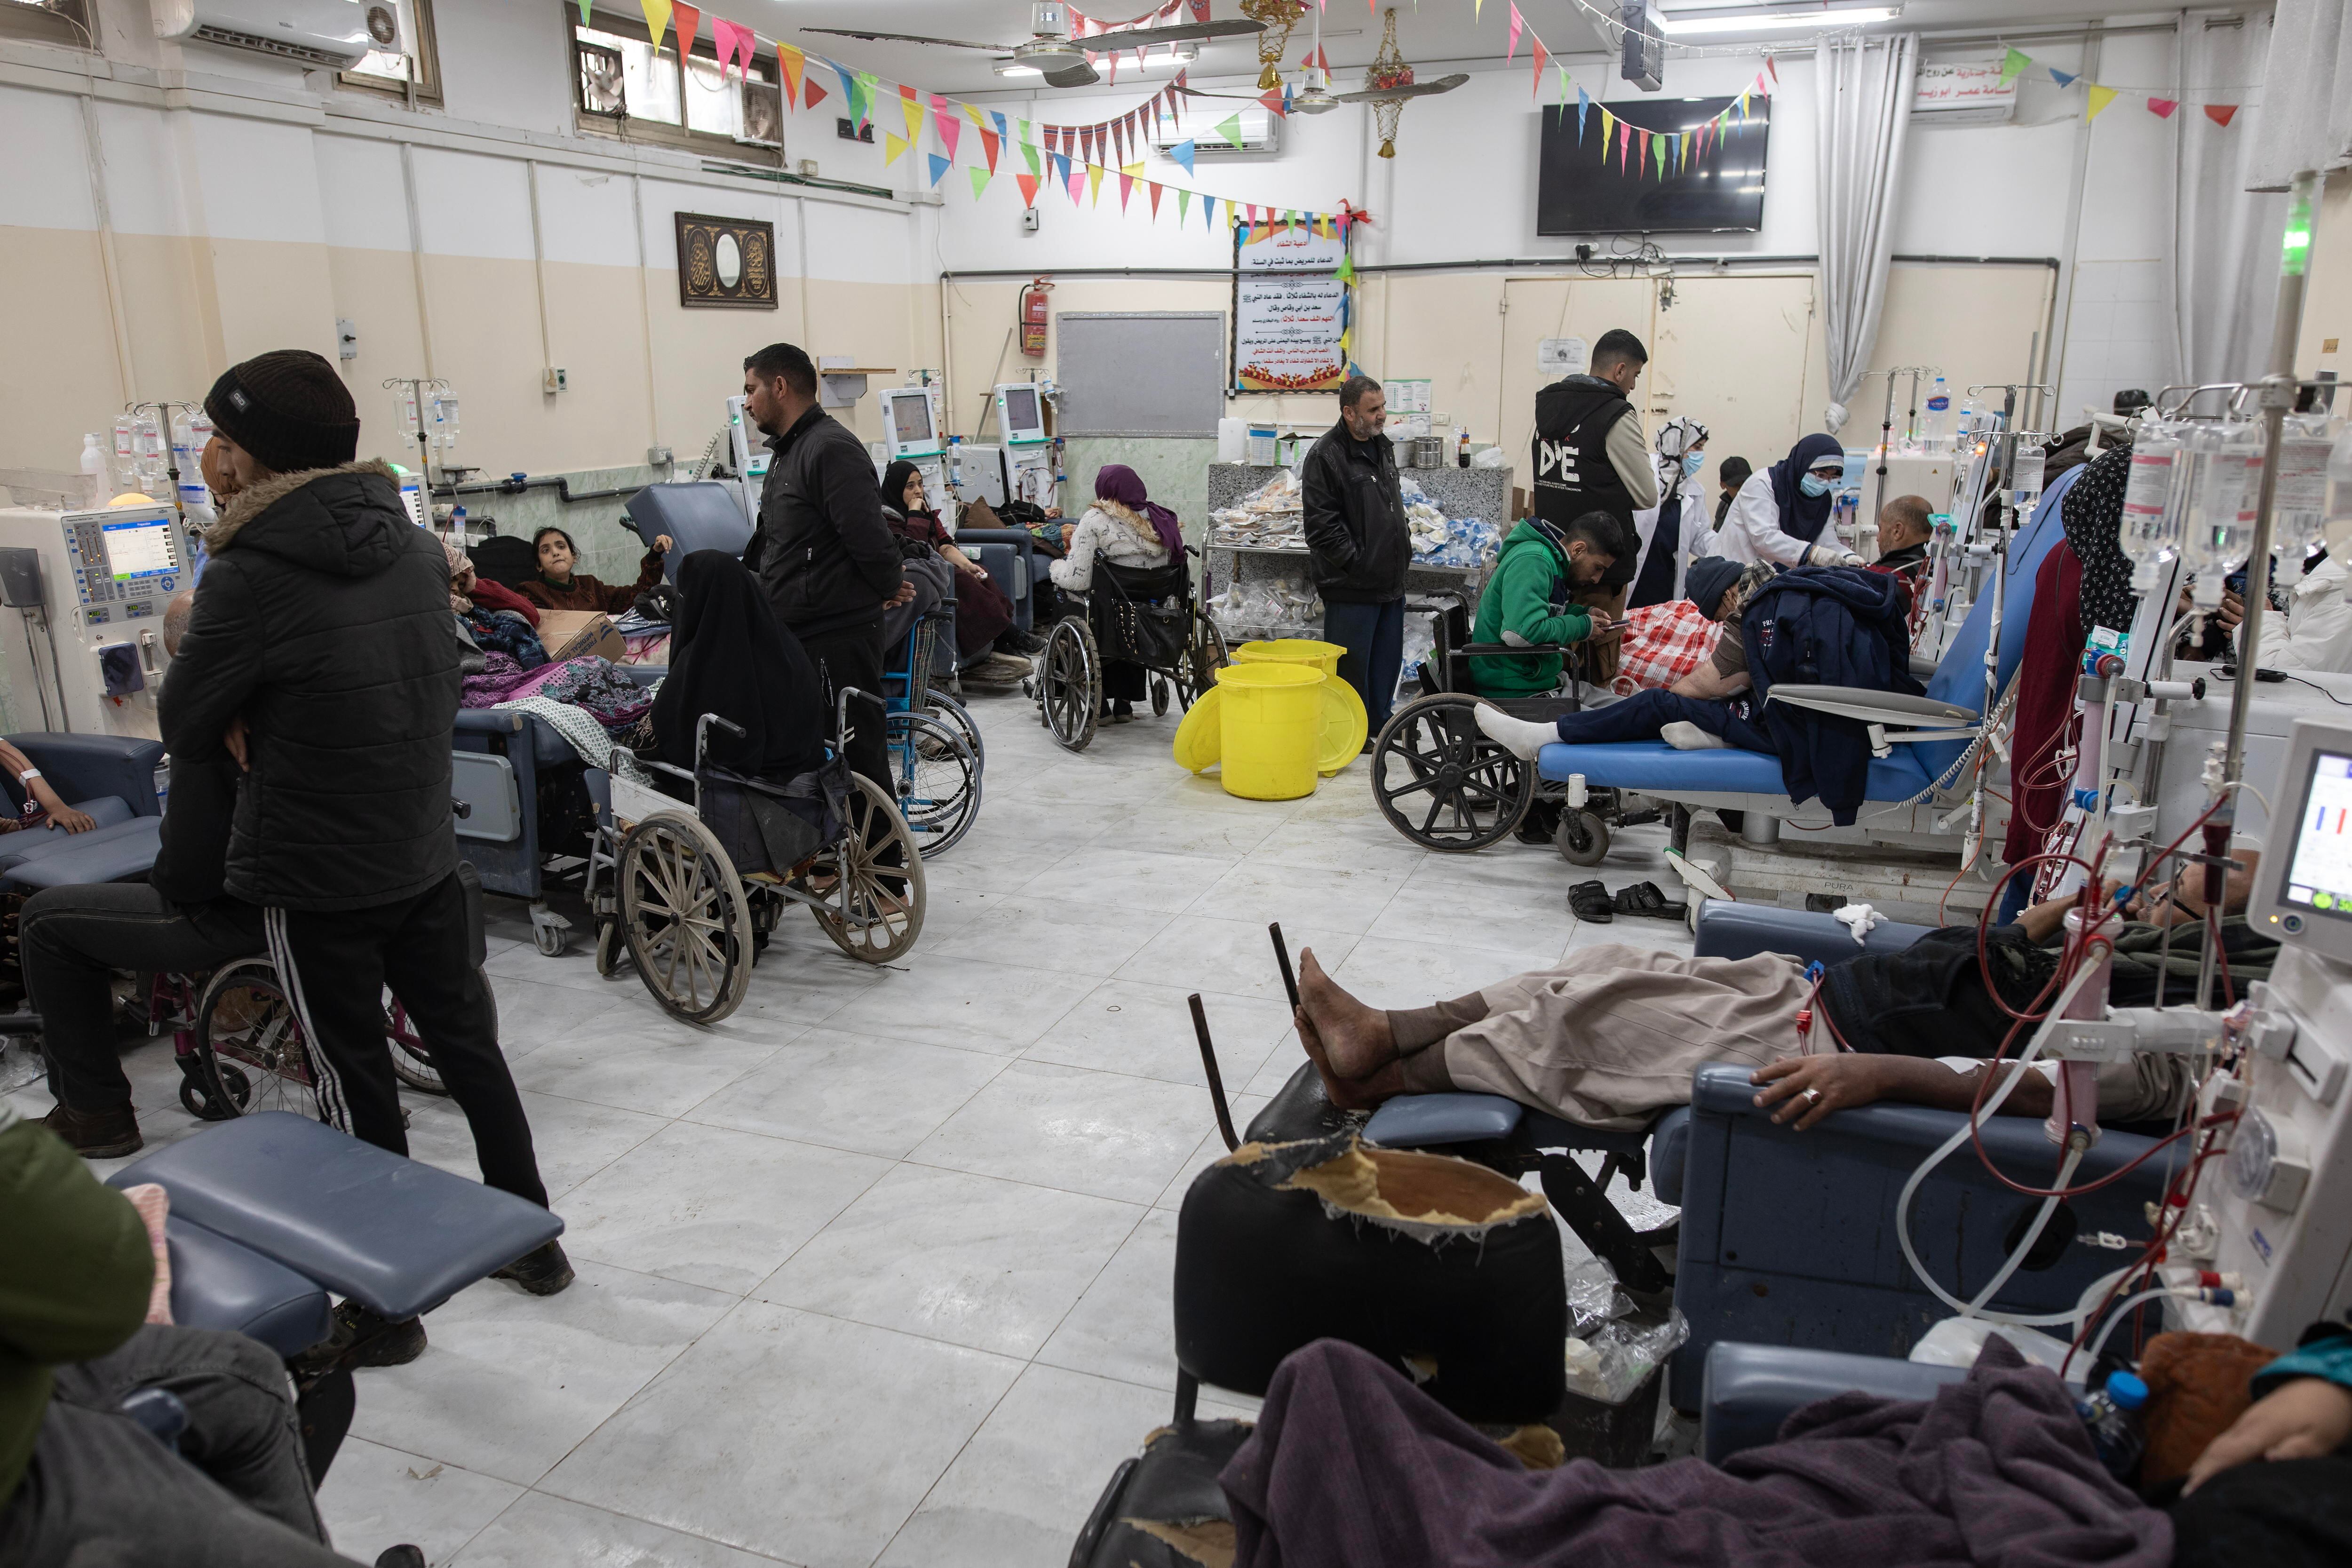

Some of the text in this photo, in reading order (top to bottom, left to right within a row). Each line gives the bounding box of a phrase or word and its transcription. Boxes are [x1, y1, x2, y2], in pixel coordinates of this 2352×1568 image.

[1942, 68, 1954, 77] عن
[1955, 87, 1980, 98] عمر
[1267, 258, 1273, 267] في
[1275, 257, 1284, 266] ثبت
[1252, 294, 1263, 302] النبي
[570, 631, 594, 653] MEDICAL
[572, 637, 597, 659] FRESEN
[1825, 882, 1853, 891] PURA
